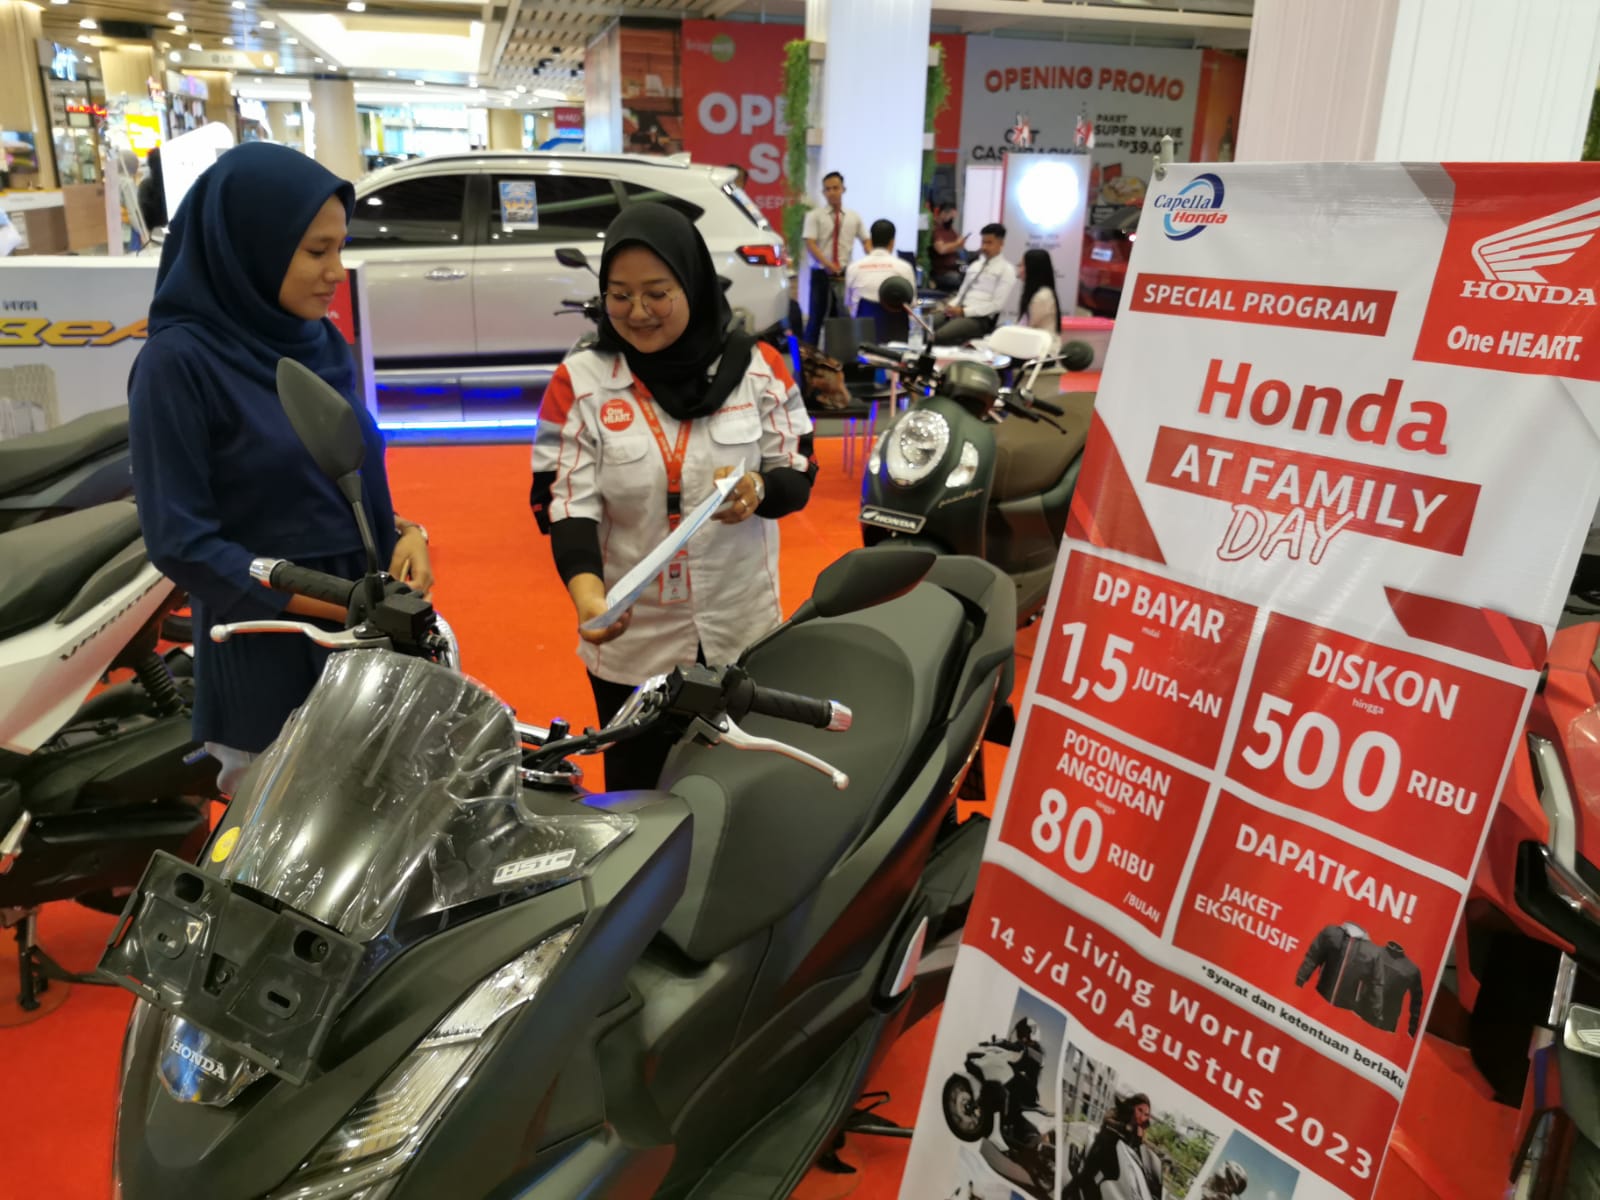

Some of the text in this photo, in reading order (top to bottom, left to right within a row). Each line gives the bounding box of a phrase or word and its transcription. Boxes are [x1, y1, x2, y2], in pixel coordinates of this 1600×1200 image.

[985, 65, 1185, 100] OPENING PROMO
[1094, 125, 1183, 138] SUPER VALUE
[1153, 193, 1213, 214] Capella
[1172, 210, 1228, 225] Honda
[1143, 282, 1378, 325] SPECIAL PROGRAM
[1459, 280, 1597, 306] HONDA
[1446, 324, 1583, 362] One HEART.
[1197, 358, 1449, 456] Honda
[874, 513, 917, 529] HONDA
[1171, 443, 1449, 535] AT FAMILY
[1216, 503, 1355, 565] DAY
[1093, 571, 1225, 644] DP BAYAR
[1061, 621, 1223, 719] 1,5 JUTA-AN
[1307, 642, 1460, 721] DISKON
[1063, 728, 1172, 797] POTONGAN
[1241, 692, 1478, 815] 500 RIBU
[1056, 752, 1165, 821] ANGSURAN
[1031, 788, 1155, 882] 80 RIBU
[1219, 883, 1283, 922] JAKET
[1235, 823, 1418, 925] DAPATKAN!
[1123, 891, 1161, 924] /BULAN
[1193, 894, 1300, 953] EKSKLUSIF
[1063, 925, 1281, 1075] Living World
[170, 1038, 227, 1082] HONDA
[989, 916, 1374, 1181] 14 s/d 20 Agustus 2023
[1251, 992, 1276, 1014] dan
[1279, 1007, 1349, 1055] ketentuan
[1353, 1048, 1405, 1090] berlaku
